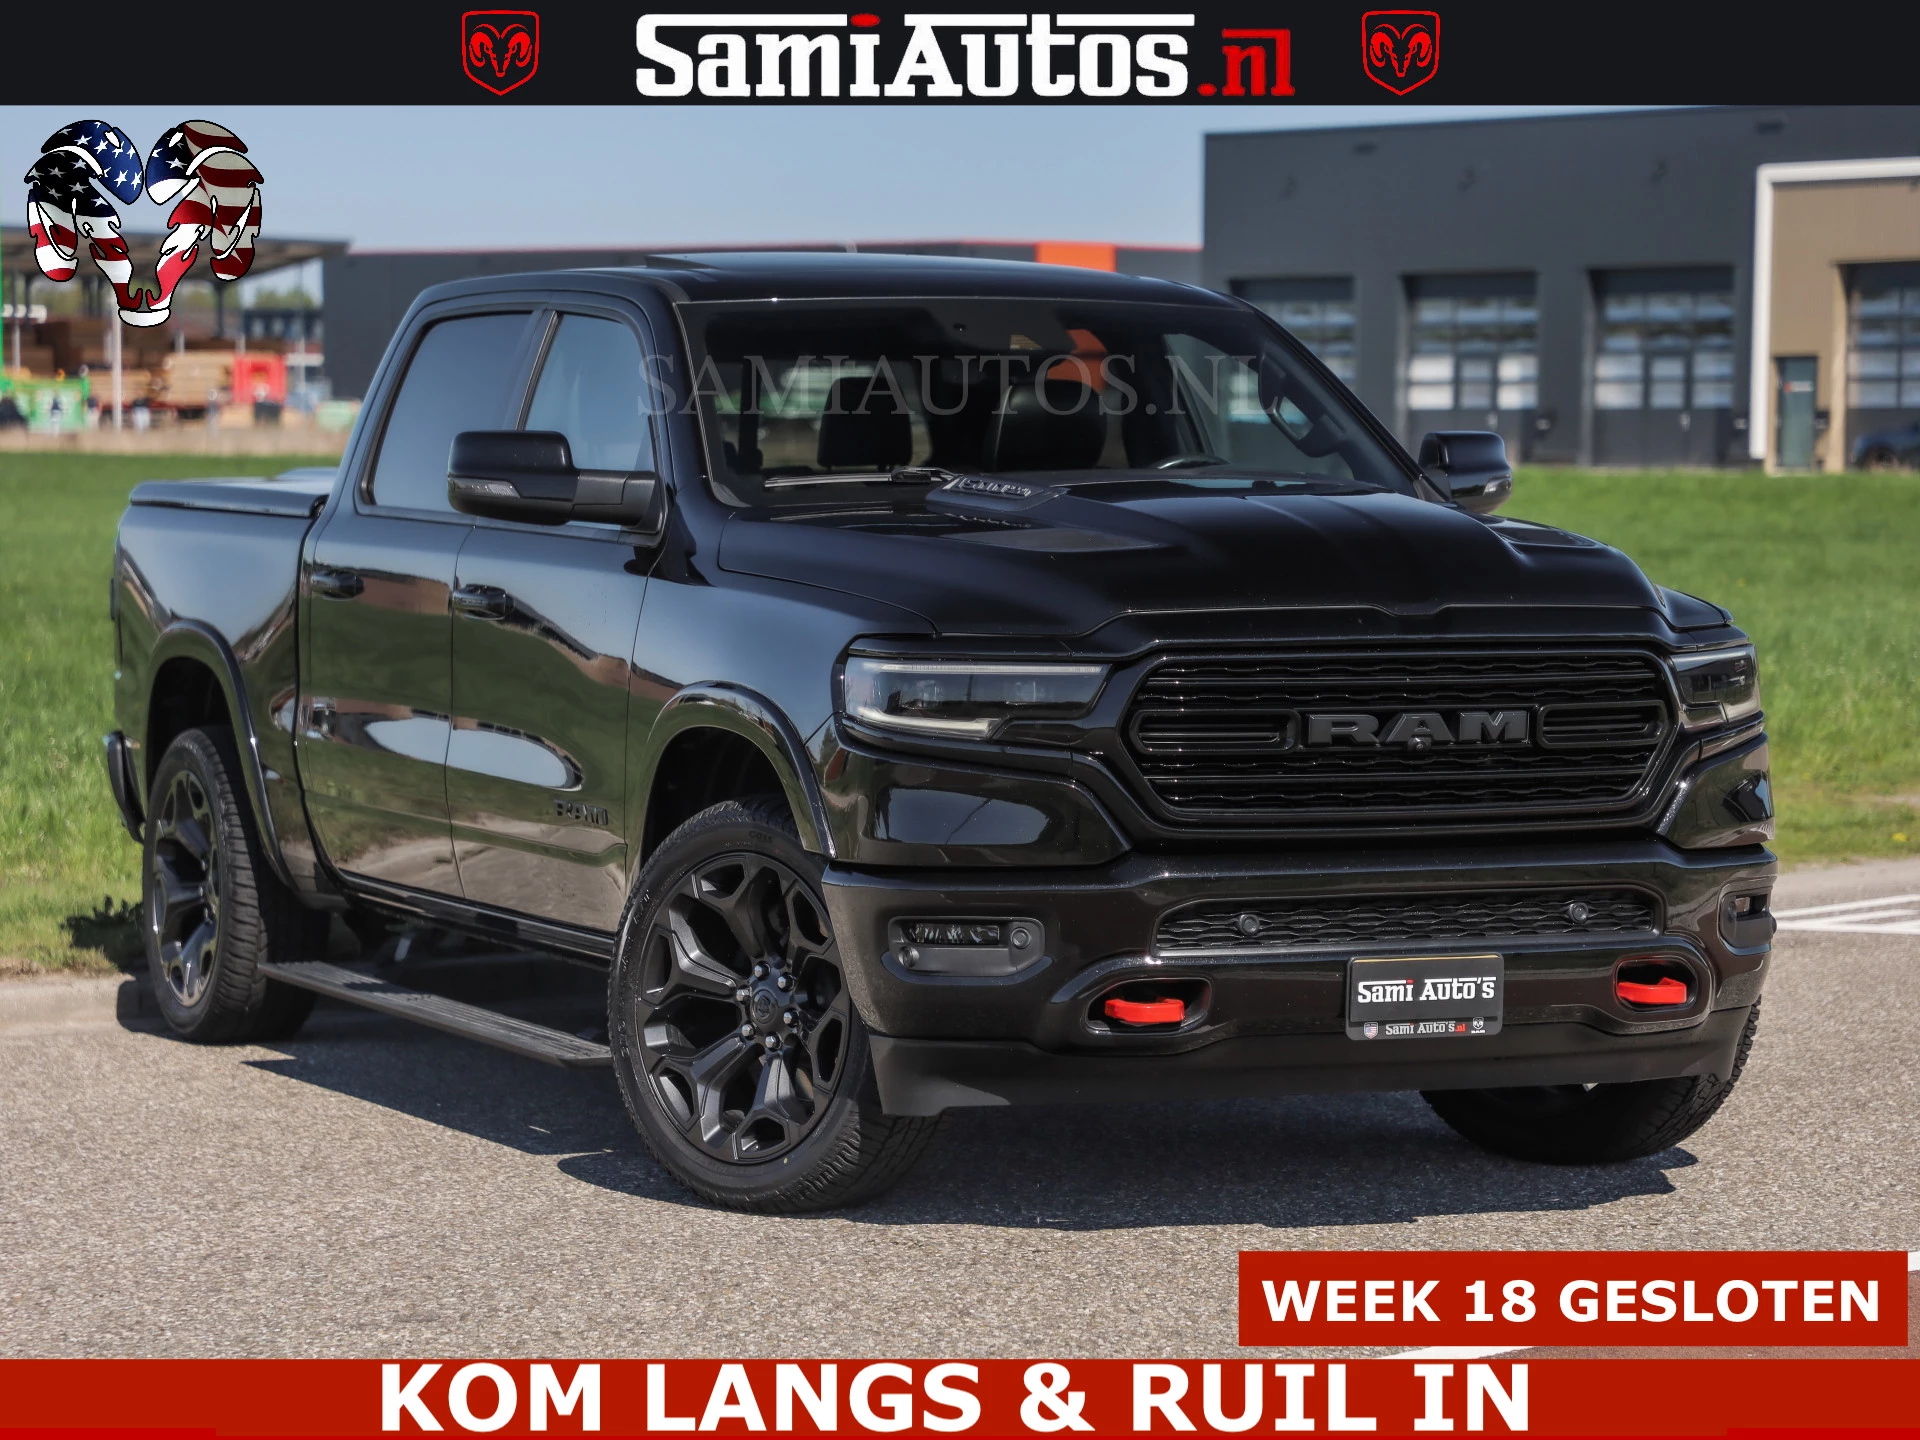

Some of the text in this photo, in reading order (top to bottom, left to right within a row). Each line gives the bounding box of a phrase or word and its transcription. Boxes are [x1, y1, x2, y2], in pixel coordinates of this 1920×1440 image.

[1308, 711, 1530, 746] RAM
[553, 799, 609, 826] RAM
[1357, 976, 1497, 1004] Sami Auto's
[1385, 1022, 1415, 1036] Sami
